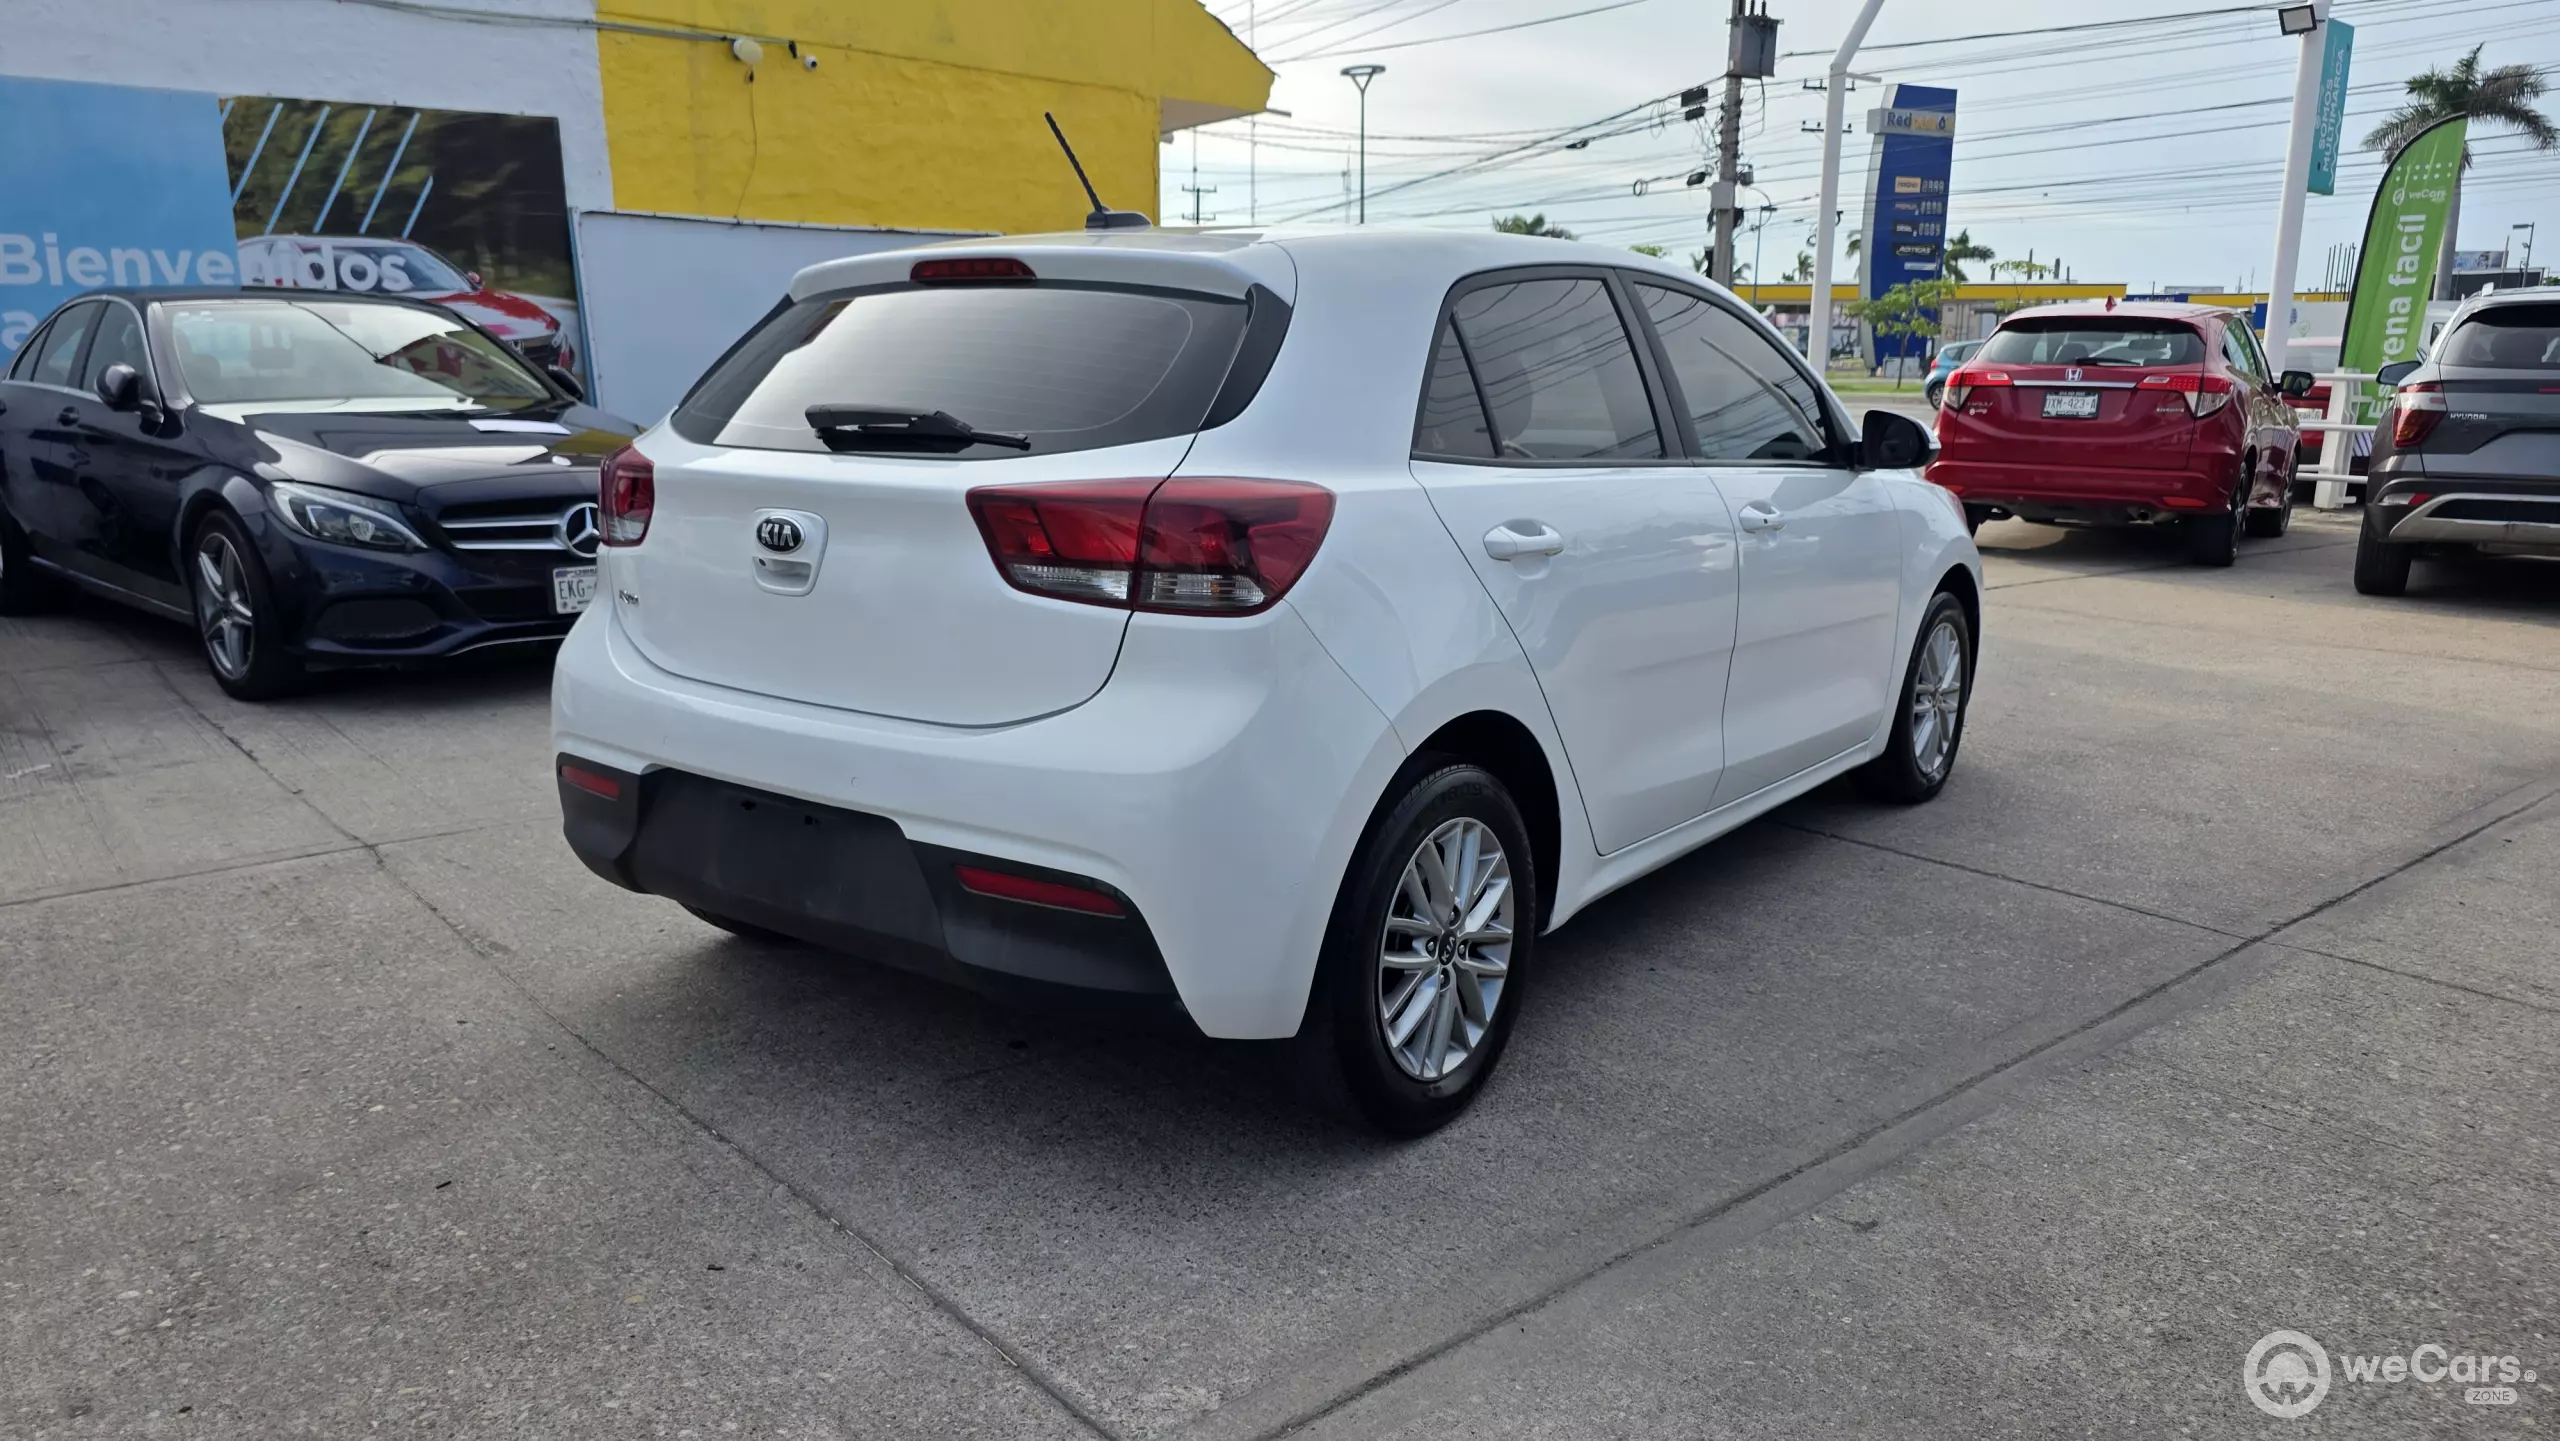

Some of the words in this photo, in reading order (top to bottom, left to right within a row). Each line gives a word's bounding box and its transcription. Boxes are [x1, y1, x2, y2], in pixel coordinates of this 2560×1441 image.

[2319, 79, 2333, 149] SOMOS
[2323, 49, 2345, 172] MULTIMARCA
[0, 231, 415, 292] Bienvenidos
[761, 522, 795, 547] KIA
[1441, 936, 1456, 962] KIA
